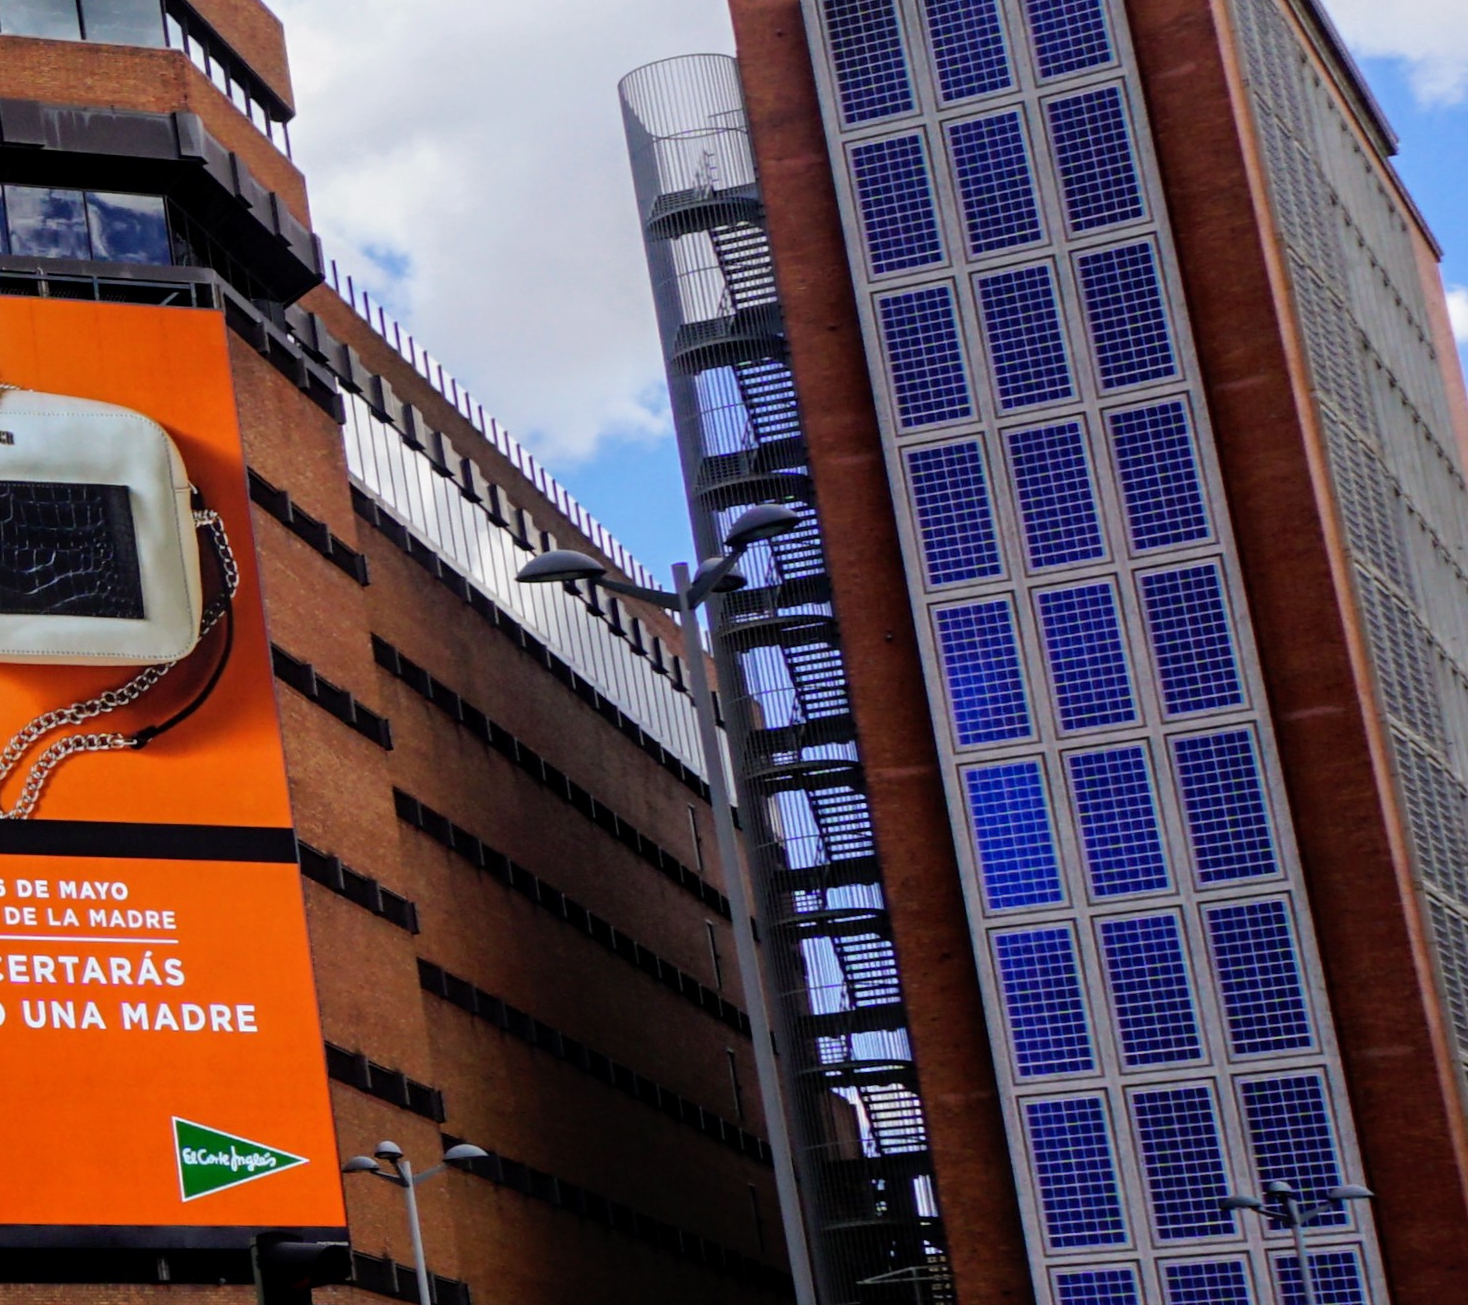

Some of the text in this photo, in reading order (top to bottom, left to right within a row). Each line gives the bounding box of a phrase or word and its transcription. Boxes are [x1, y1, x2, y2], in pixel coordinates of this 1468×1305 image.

[14, 879, 52, 900] DE
[59, 881, 129, 901] MAYO
[4, 905, 41, 927] DE
[46, 907, 82, 928] LA
[88, 908, 178, 931] MADRE
[24, 998, 106, 1031] UNA
[122, 999, 259, 1034] MADRE
[182, 1146, 277, 1172] El Corte Inglés
